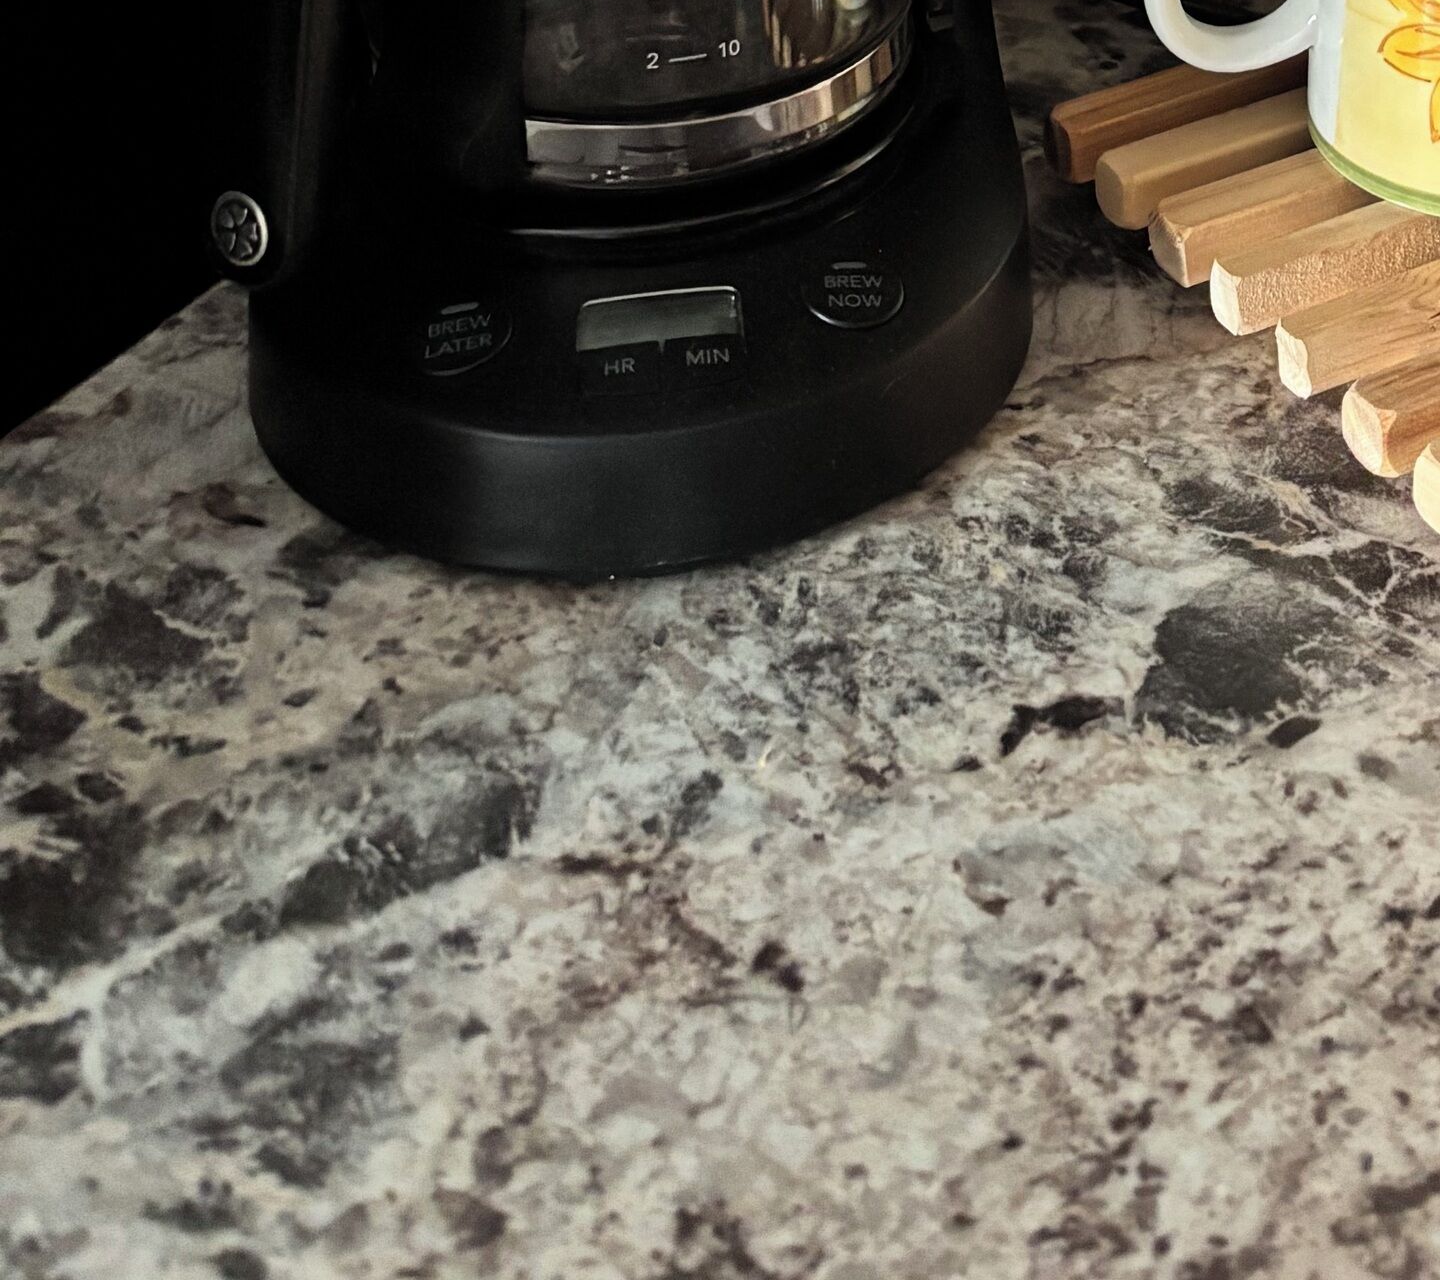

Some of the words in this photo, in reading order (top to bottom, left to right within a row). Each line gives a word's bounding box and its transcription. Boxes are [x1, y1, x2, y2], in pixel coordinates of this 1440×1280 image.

[646, 53, 659, 69] 2
[718, 40, 740, 57] 10
[824, 274, 883, 289] BREW
[828, 293, 882, 309] NOW
[428, 312, 491, 338] BREW
[424, 333, 492, 359] LATER
[604, 356, 636, 377] HR
[685, 346, 730, 368] MIN
